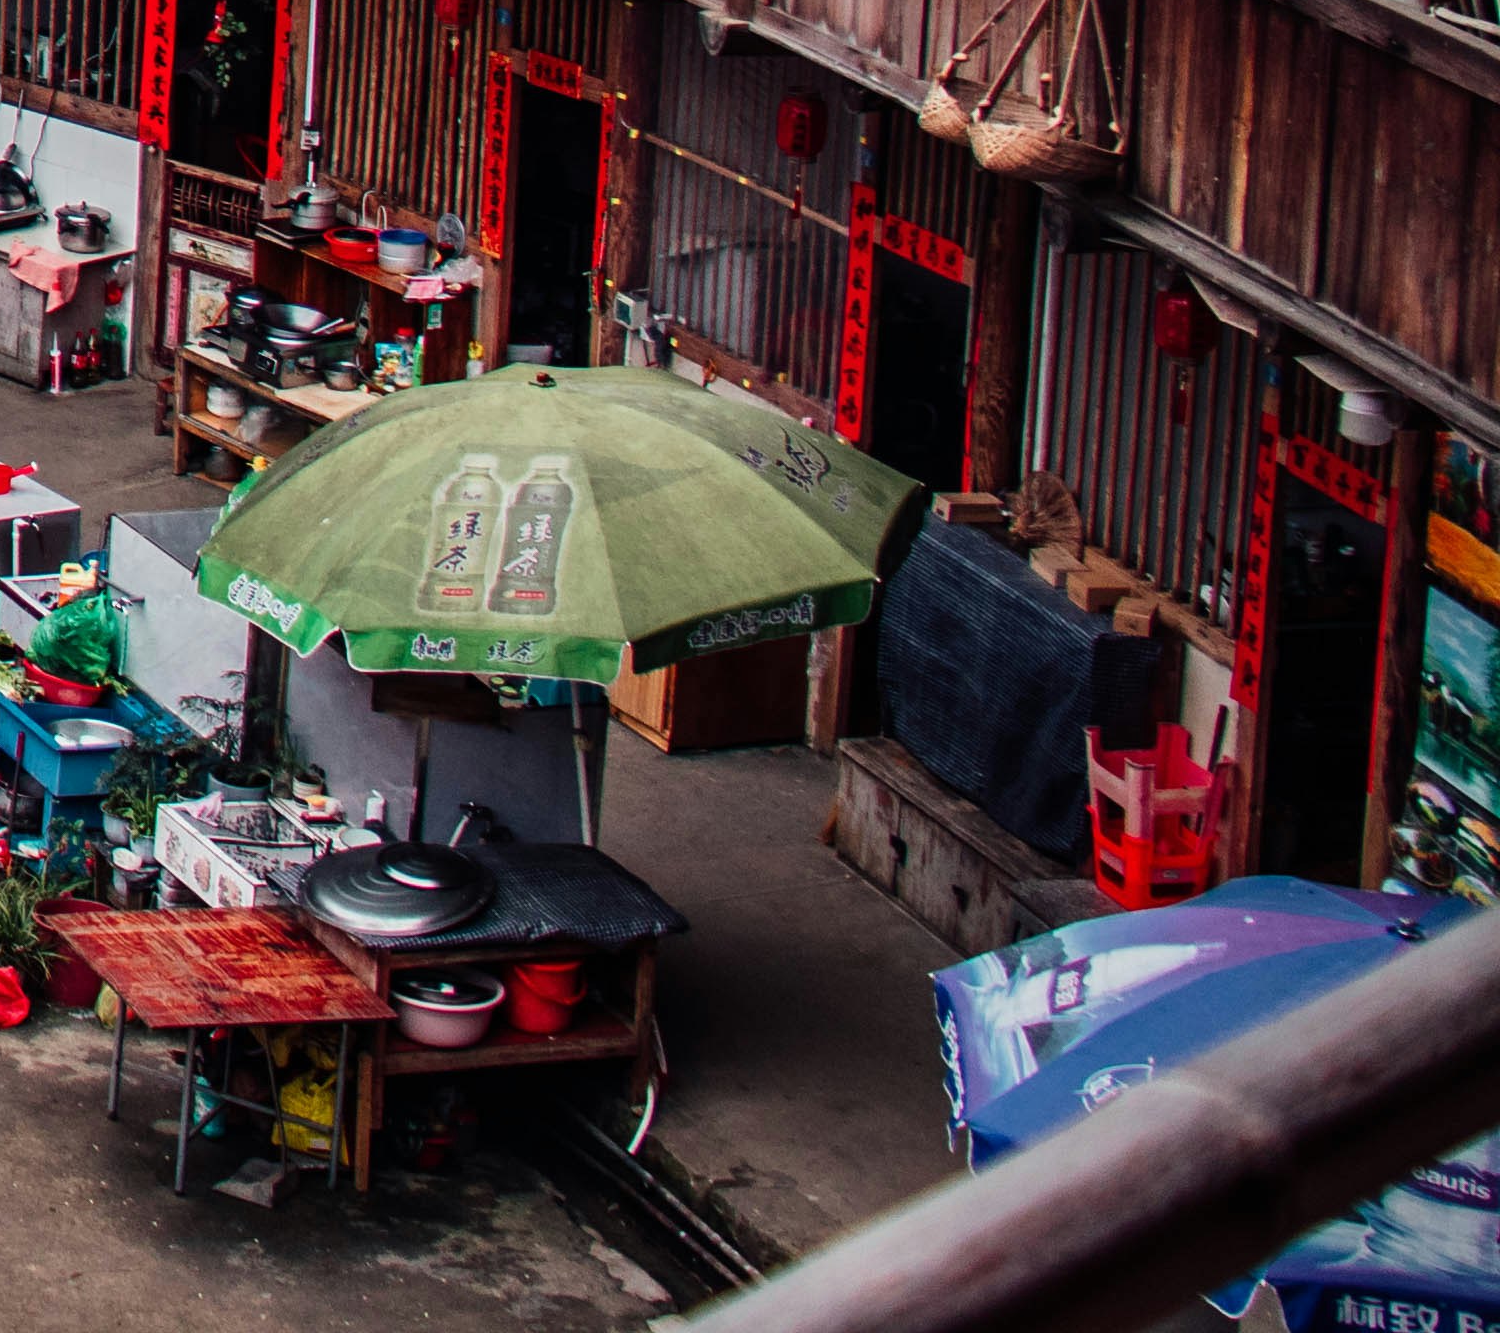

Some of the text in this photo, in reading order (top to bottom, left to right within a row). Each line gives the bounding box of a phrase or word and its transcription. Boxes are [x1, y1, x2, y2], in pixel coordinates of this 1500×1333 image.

[688, 592, 816, 648] 健康好心情
[1411, 1166, 1493, 1201] eautis
